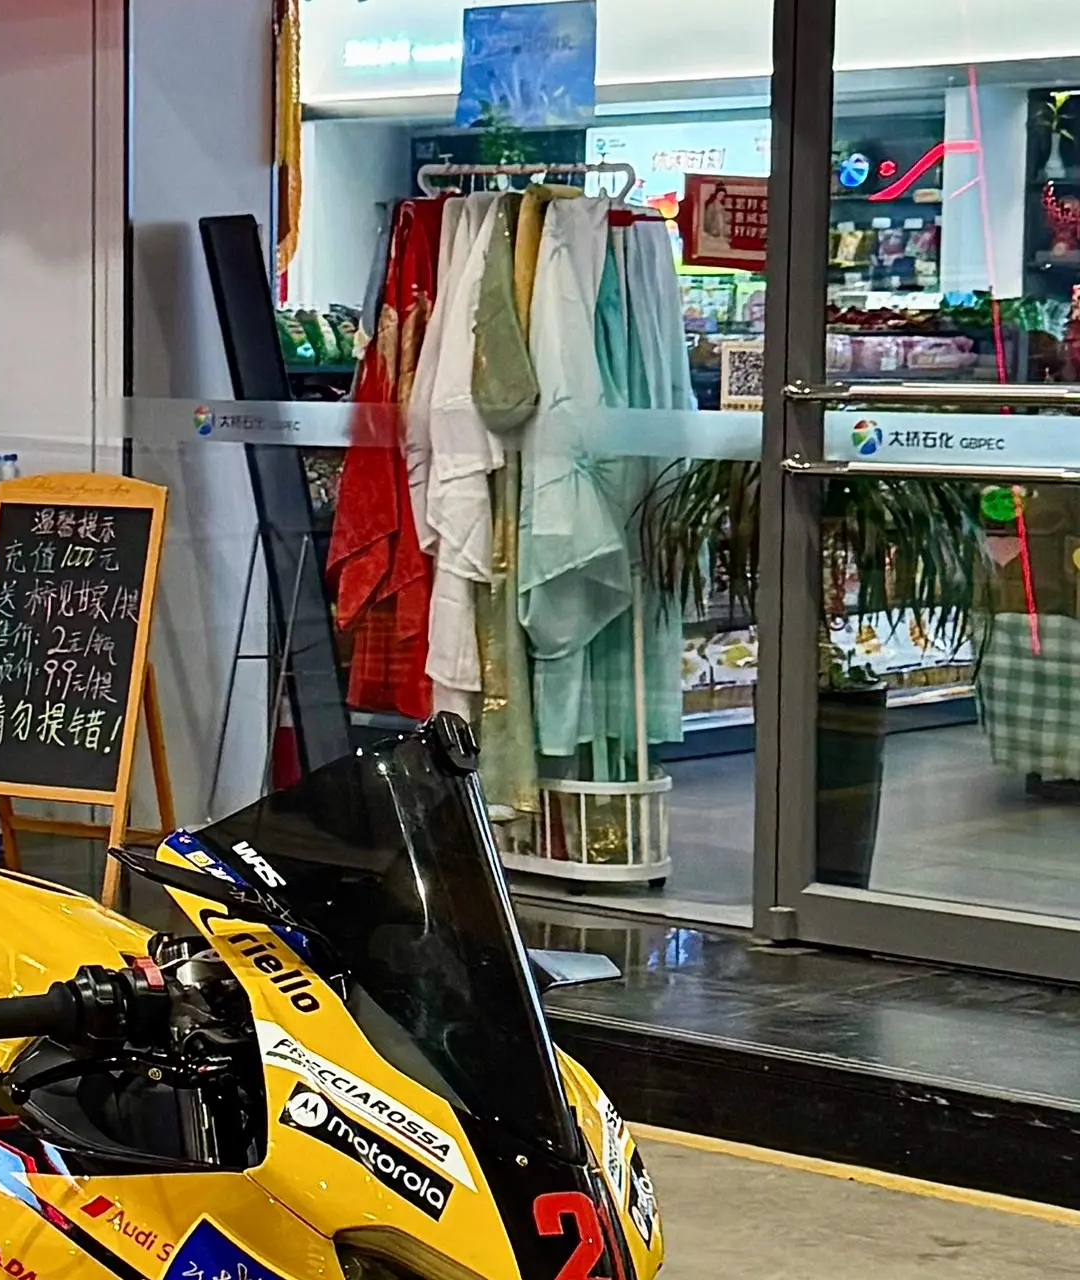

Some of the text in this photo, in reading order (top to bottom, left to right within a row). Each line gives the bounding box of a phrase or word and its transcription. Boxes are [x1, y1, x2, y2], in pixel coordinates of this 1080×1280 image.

[888, 431, 1005, 450] 大桥石化 GBPEC
[30, 508, 116, 543] 温馨提示
[228, 932, 320, 1014] riello
[327, 1114, 446, 1212] motorola
[106, 1209, 158, 1251] Audi
